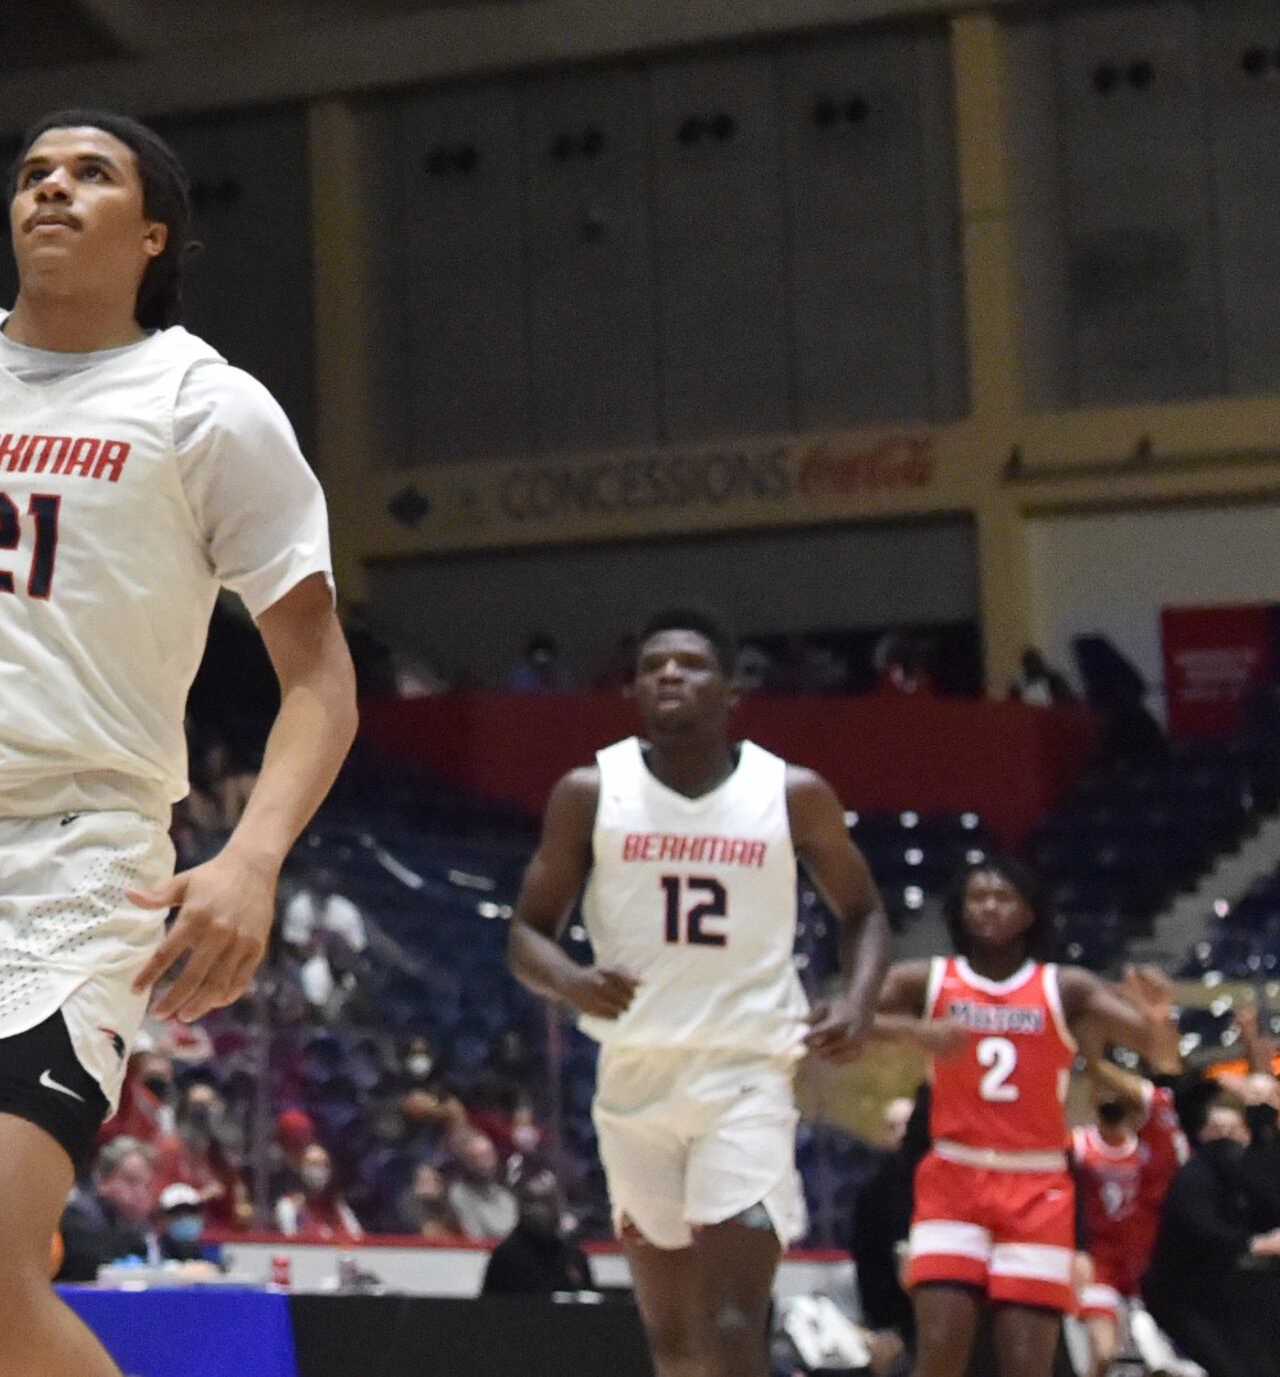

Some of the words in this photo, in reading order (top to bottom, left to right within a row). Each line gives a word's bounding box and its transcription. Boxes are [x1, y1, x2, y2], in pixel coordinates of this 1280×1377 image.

[500, 447, 793, 519] CONCESSIONS
[622, 833, 768, 868] BERKMAR
[660, 875, 727, 947] 12
[976, 1035, 1020, 1103] 2
